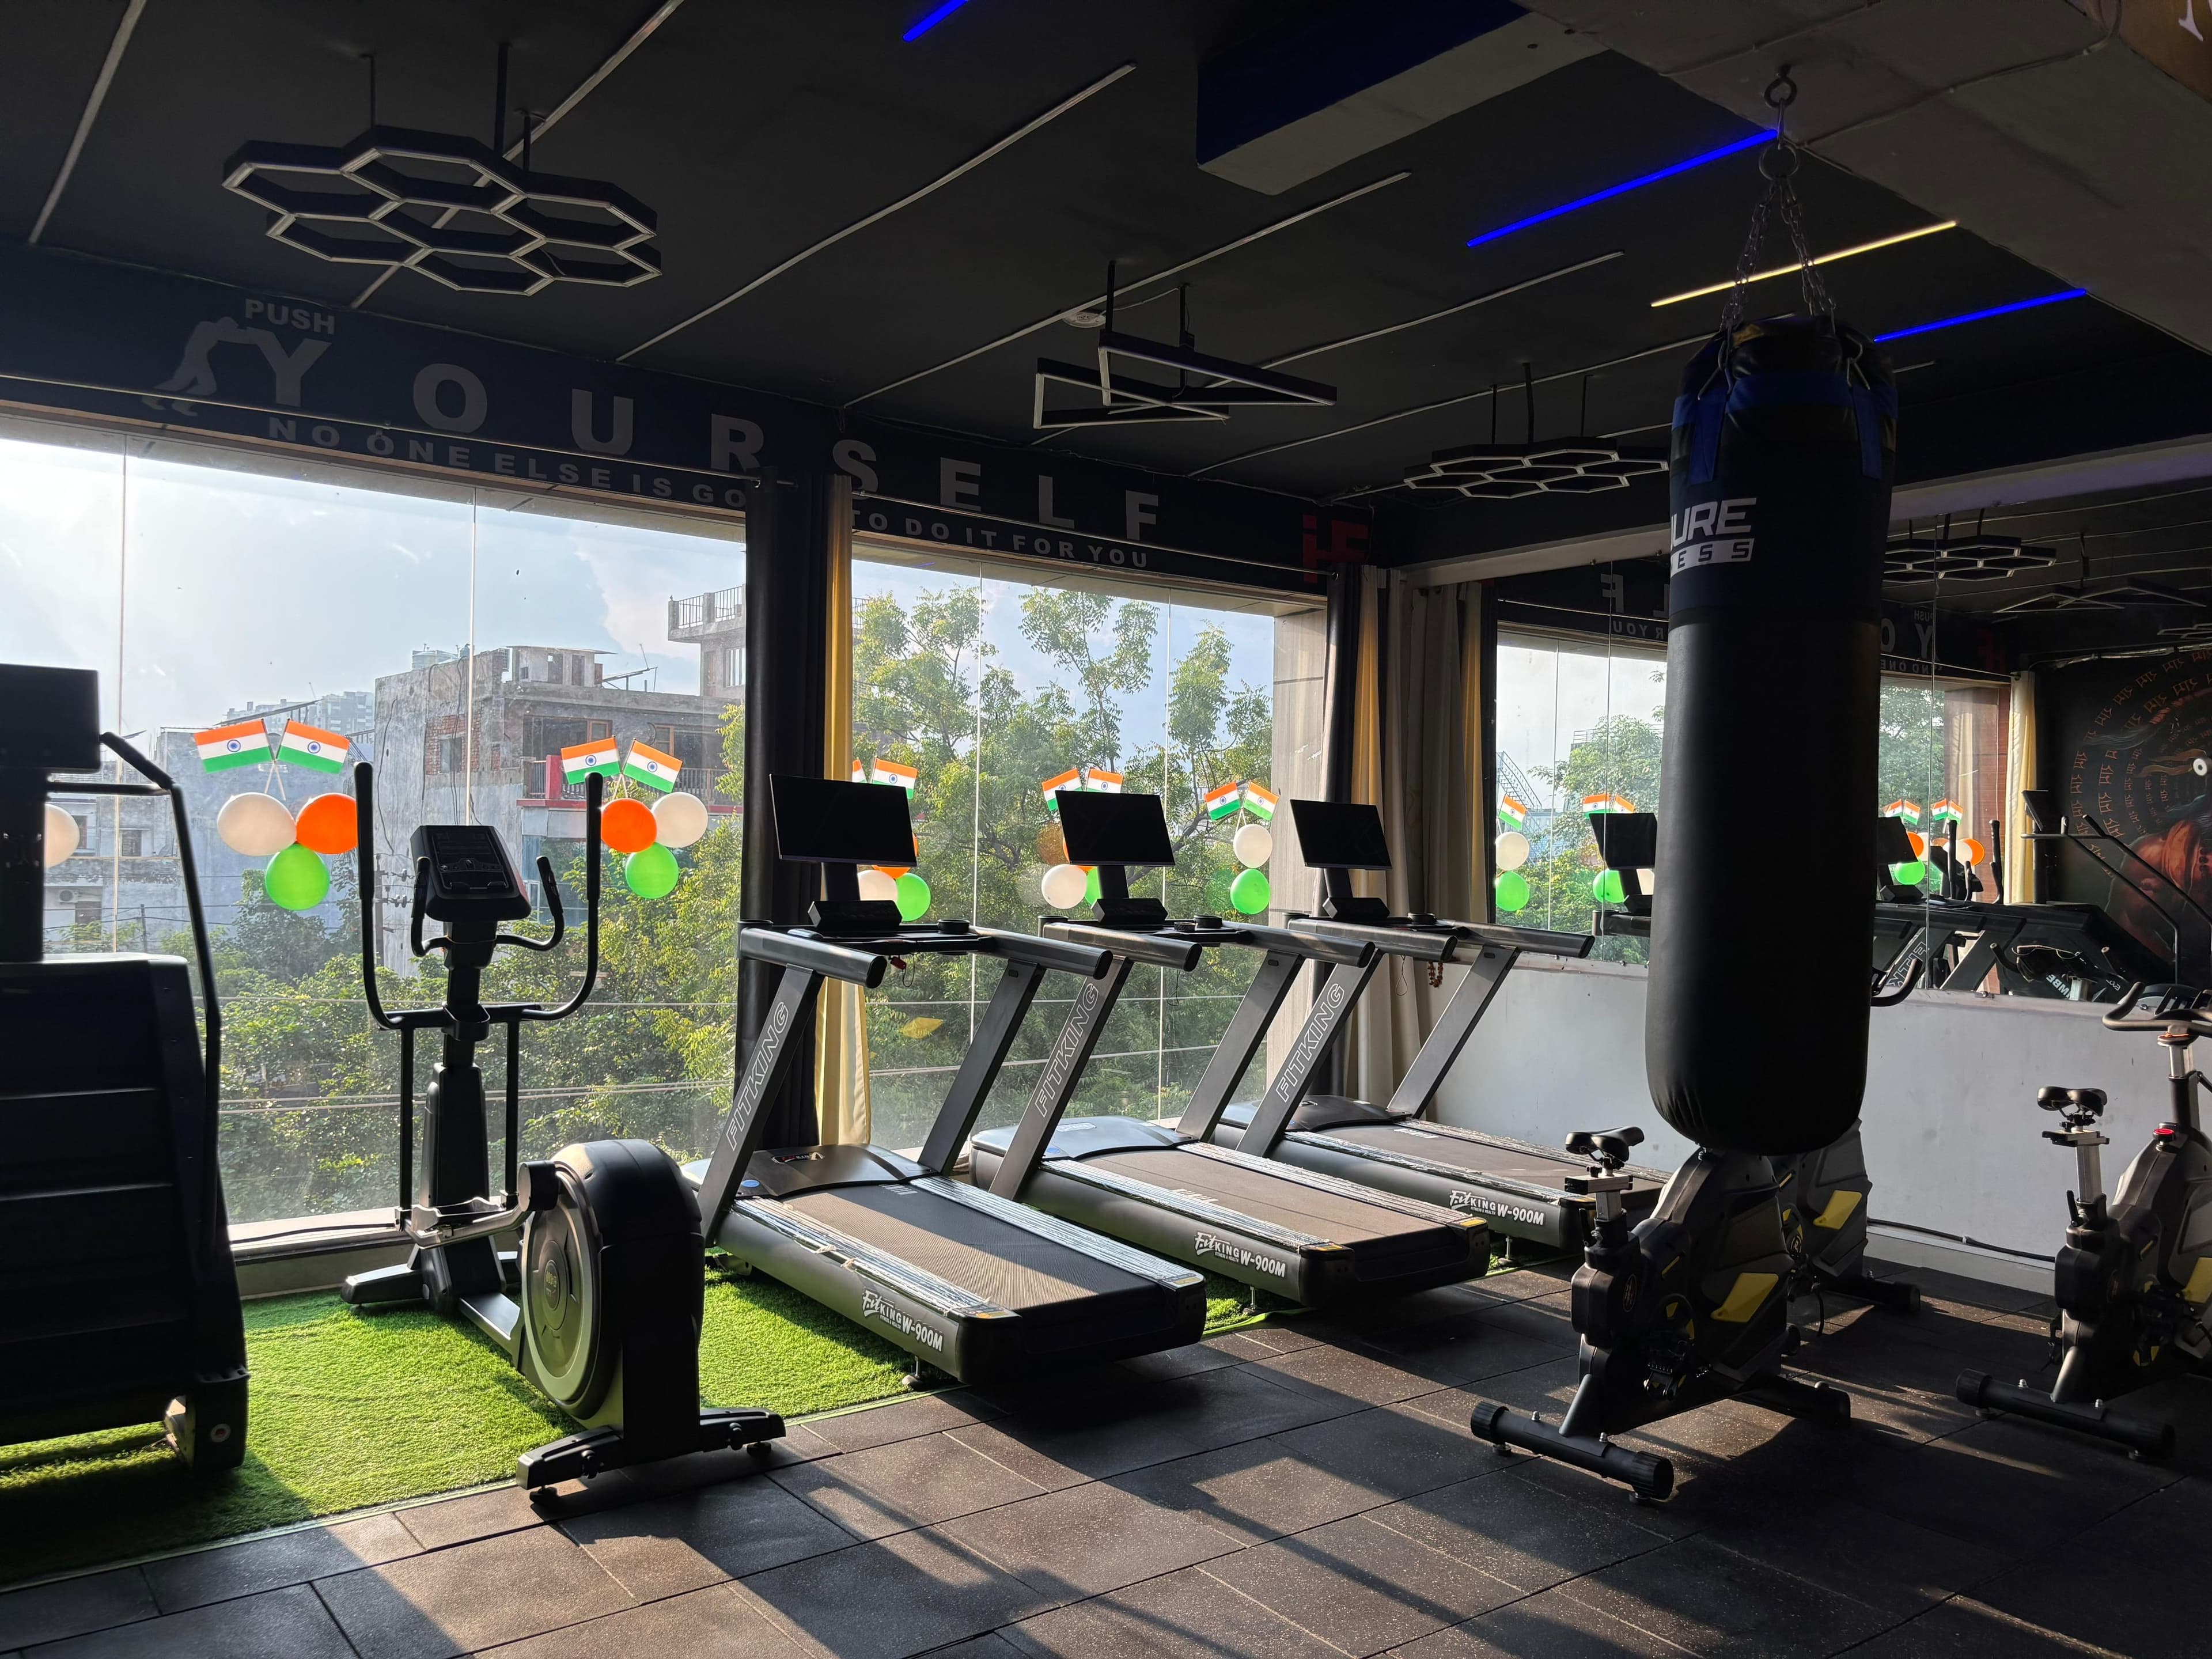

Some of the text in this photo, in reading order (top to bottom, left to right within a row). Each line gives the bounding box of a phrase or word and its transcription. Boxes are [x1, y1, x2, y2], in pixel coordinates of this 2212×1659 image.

[245, 298, 335, 335] PUSH
[269, 416, 341, 447] NO
[367, 431, 471, 468] ONE
[495, 453, 611, 488] ELSE
[635, 474, 672, 497] IS
[692, 484, 746, 508] GO
[906, 518, 949, 540] DO
[966, 528, 997, 547] IT
[1013, 536, 1074, 558] FOR
[1088, 546, 1147, 567] YOU
[1671, 497, 1758, 551] URE
[1671, 541, 1750, 572] ESS
[1035, 983, 1099, 1118] FITKING
[1276, 983, 1344, 1103] FITKING
[725, 1001, 789, 1152] FITKING
[1497, 1203, 1544, 1226] W-900M
[1241, 1249, 1286, 1278] W-900M
[902, 1315, 943, 1352] W-900M
